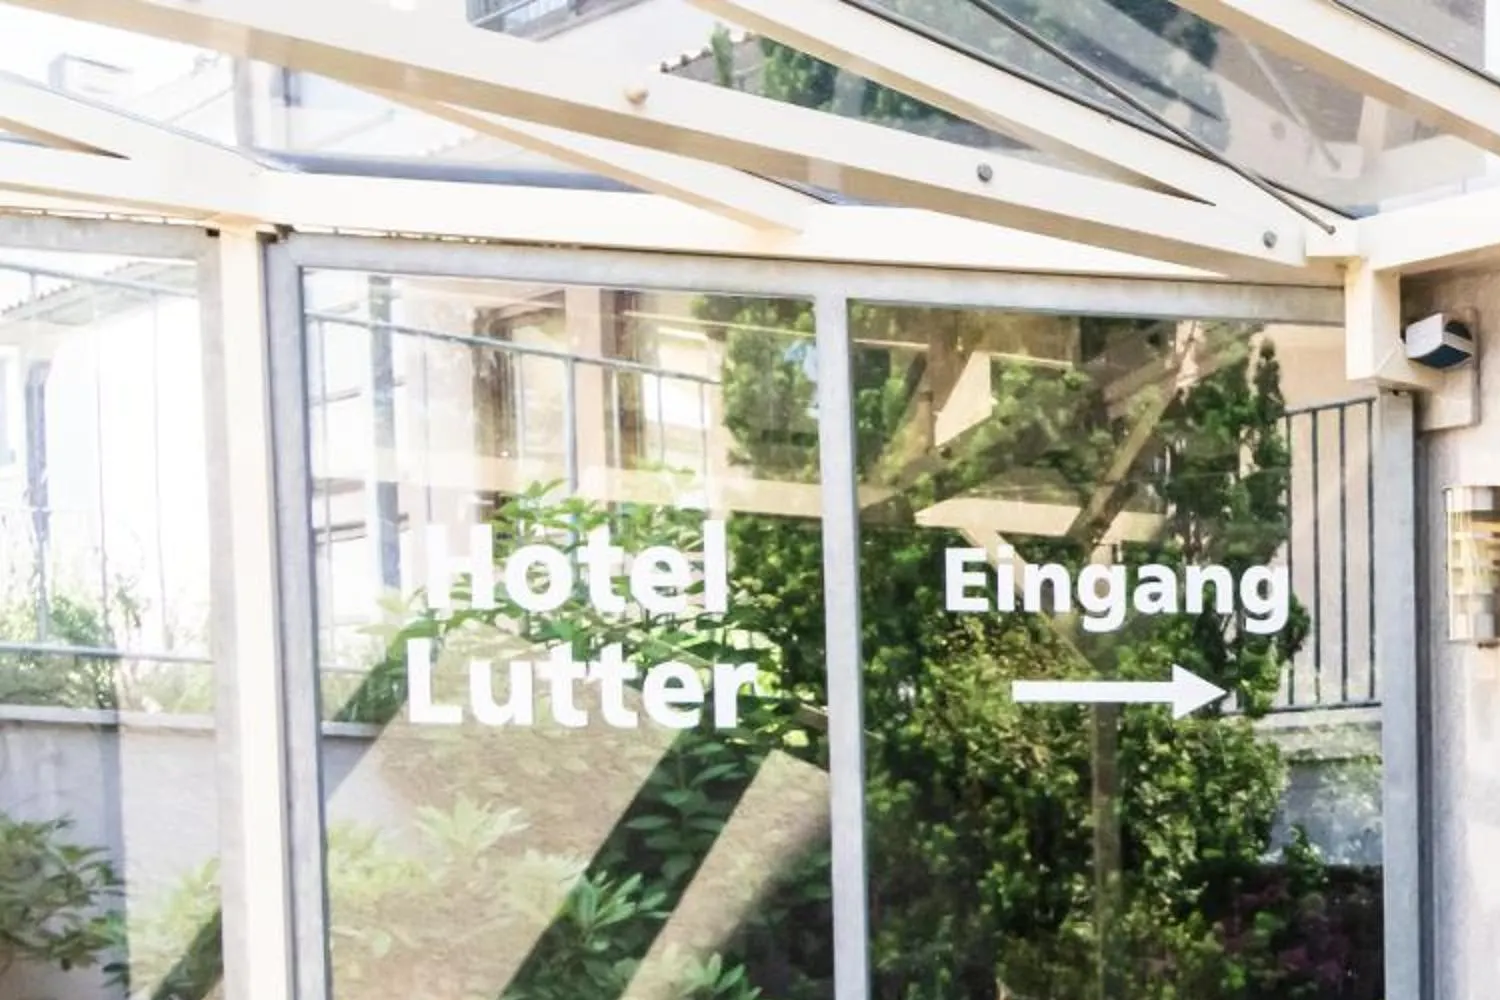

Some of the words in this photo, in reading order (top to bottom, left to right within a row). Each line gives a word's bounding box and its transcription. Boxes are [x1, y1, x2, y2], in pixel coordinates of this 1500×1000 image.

[427, 519, 729, 614] Hotel
[945, 545, 1291, 633] Eingang
[407, 637, 764, 730] Lutter
